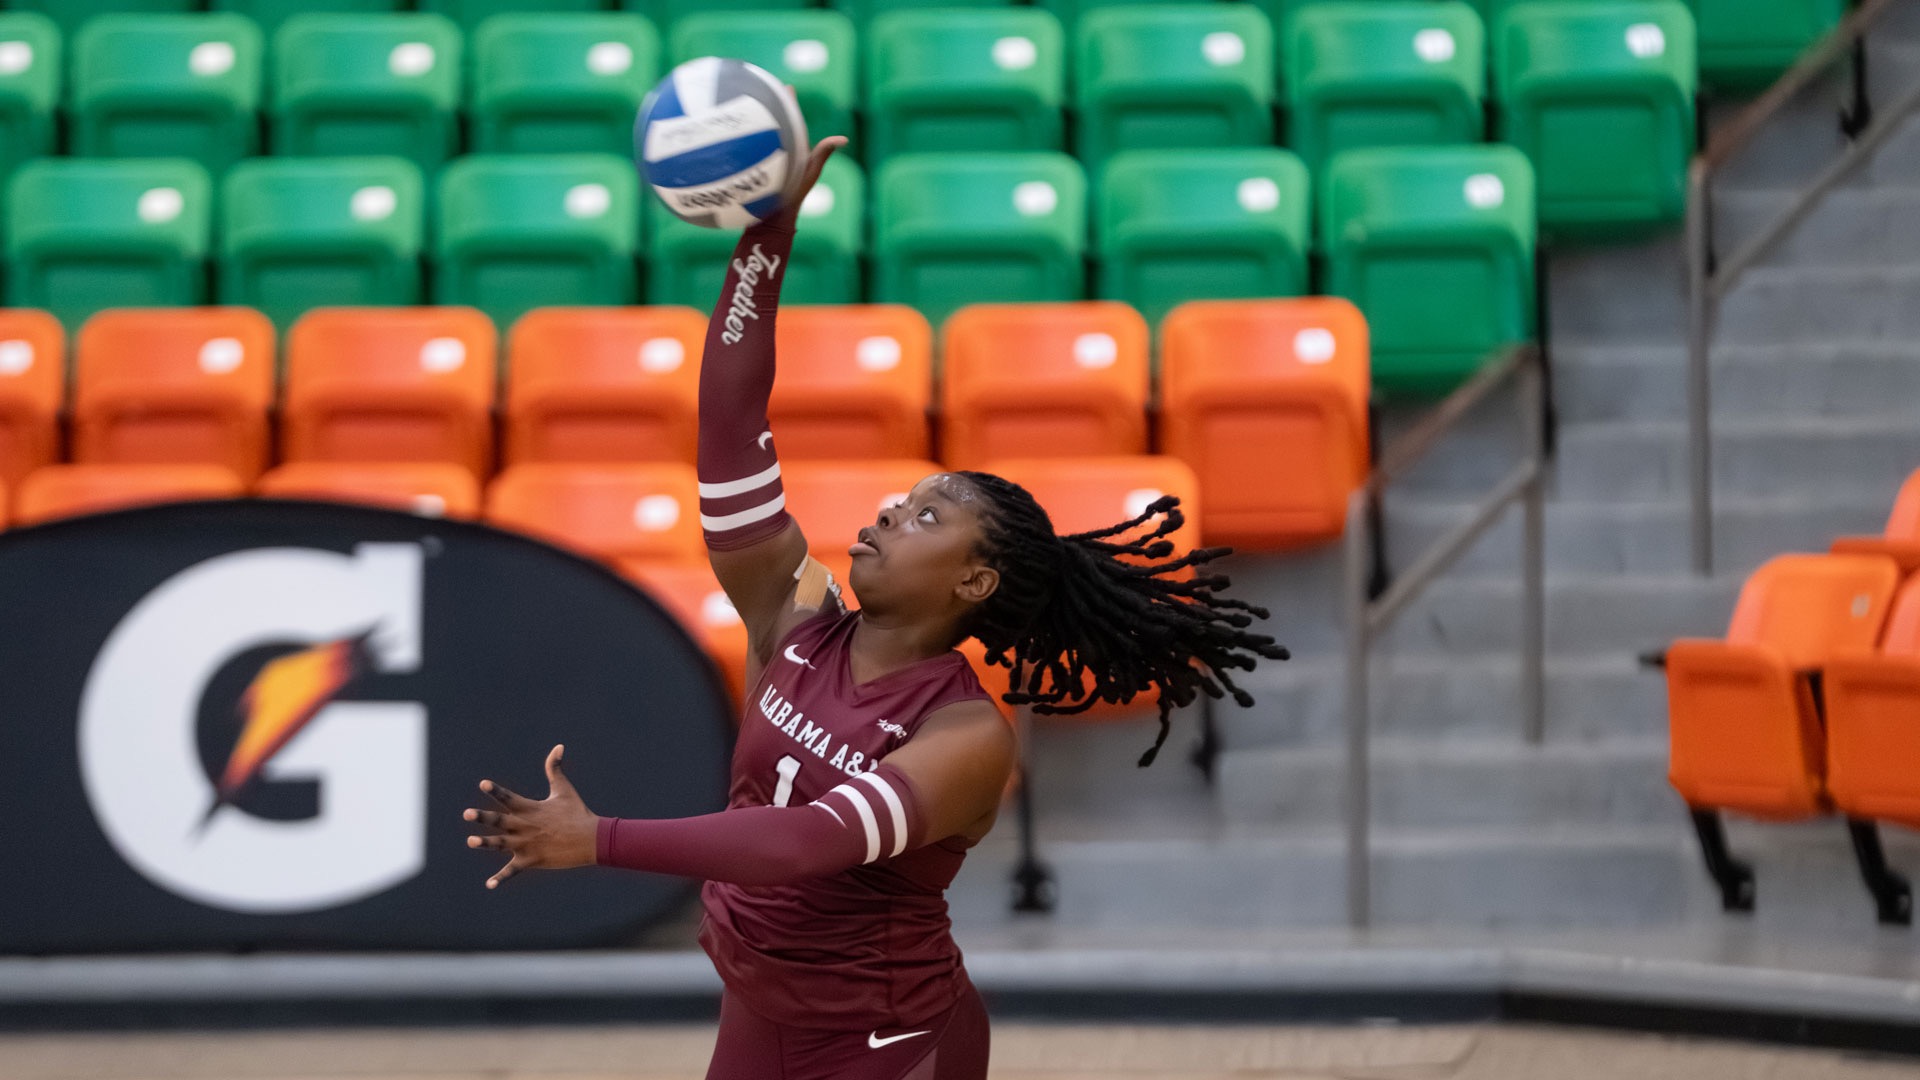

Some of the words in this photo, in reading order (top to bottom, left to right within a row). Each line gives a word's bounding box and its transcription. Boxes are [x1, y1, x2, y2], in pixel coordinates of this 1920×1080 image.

[721, 243, 781, 345] Together
[78, 541, 427, 913] G
[829, 743, 879, 777] A&
